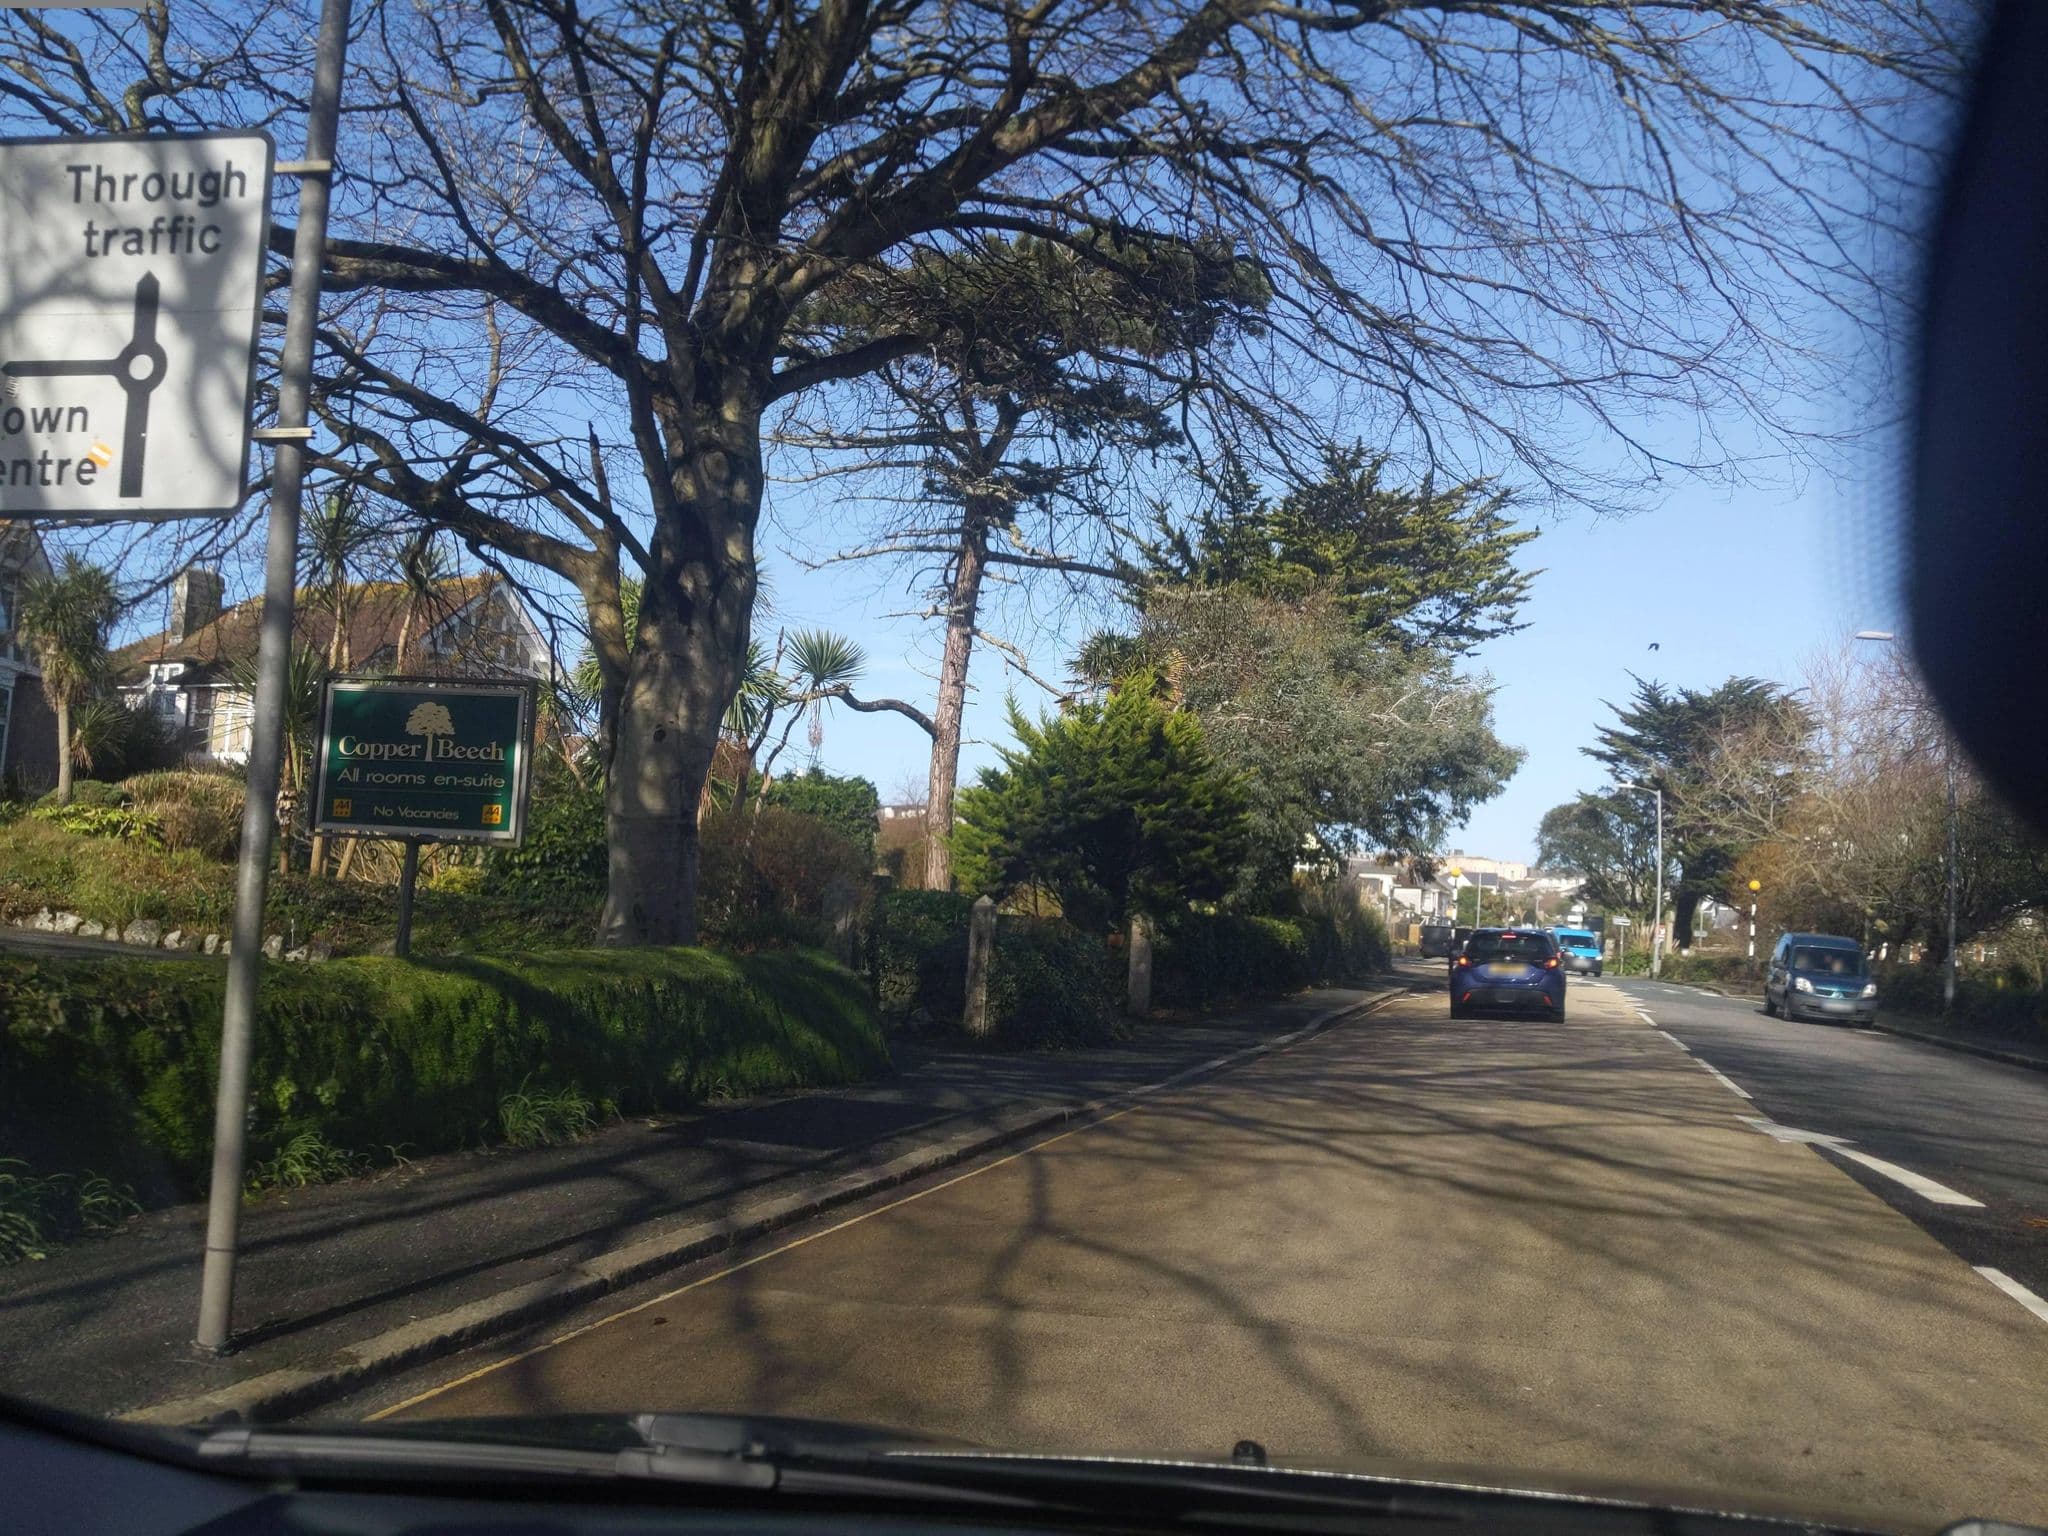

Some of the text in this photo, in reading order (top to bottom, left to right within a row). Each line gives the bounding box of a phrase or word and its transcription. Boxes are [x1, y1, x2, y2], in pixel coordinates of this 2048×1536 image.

[67, 161, 246, 206] Through
[83, 215, 222, 257] traffic
[0, 402, 89, 435] own
[339, 736, 505, 762] Copper Beech
[337, 768, 505, 788] All rooms en-suite
[373, 805, 459, 820] No Vacancies
